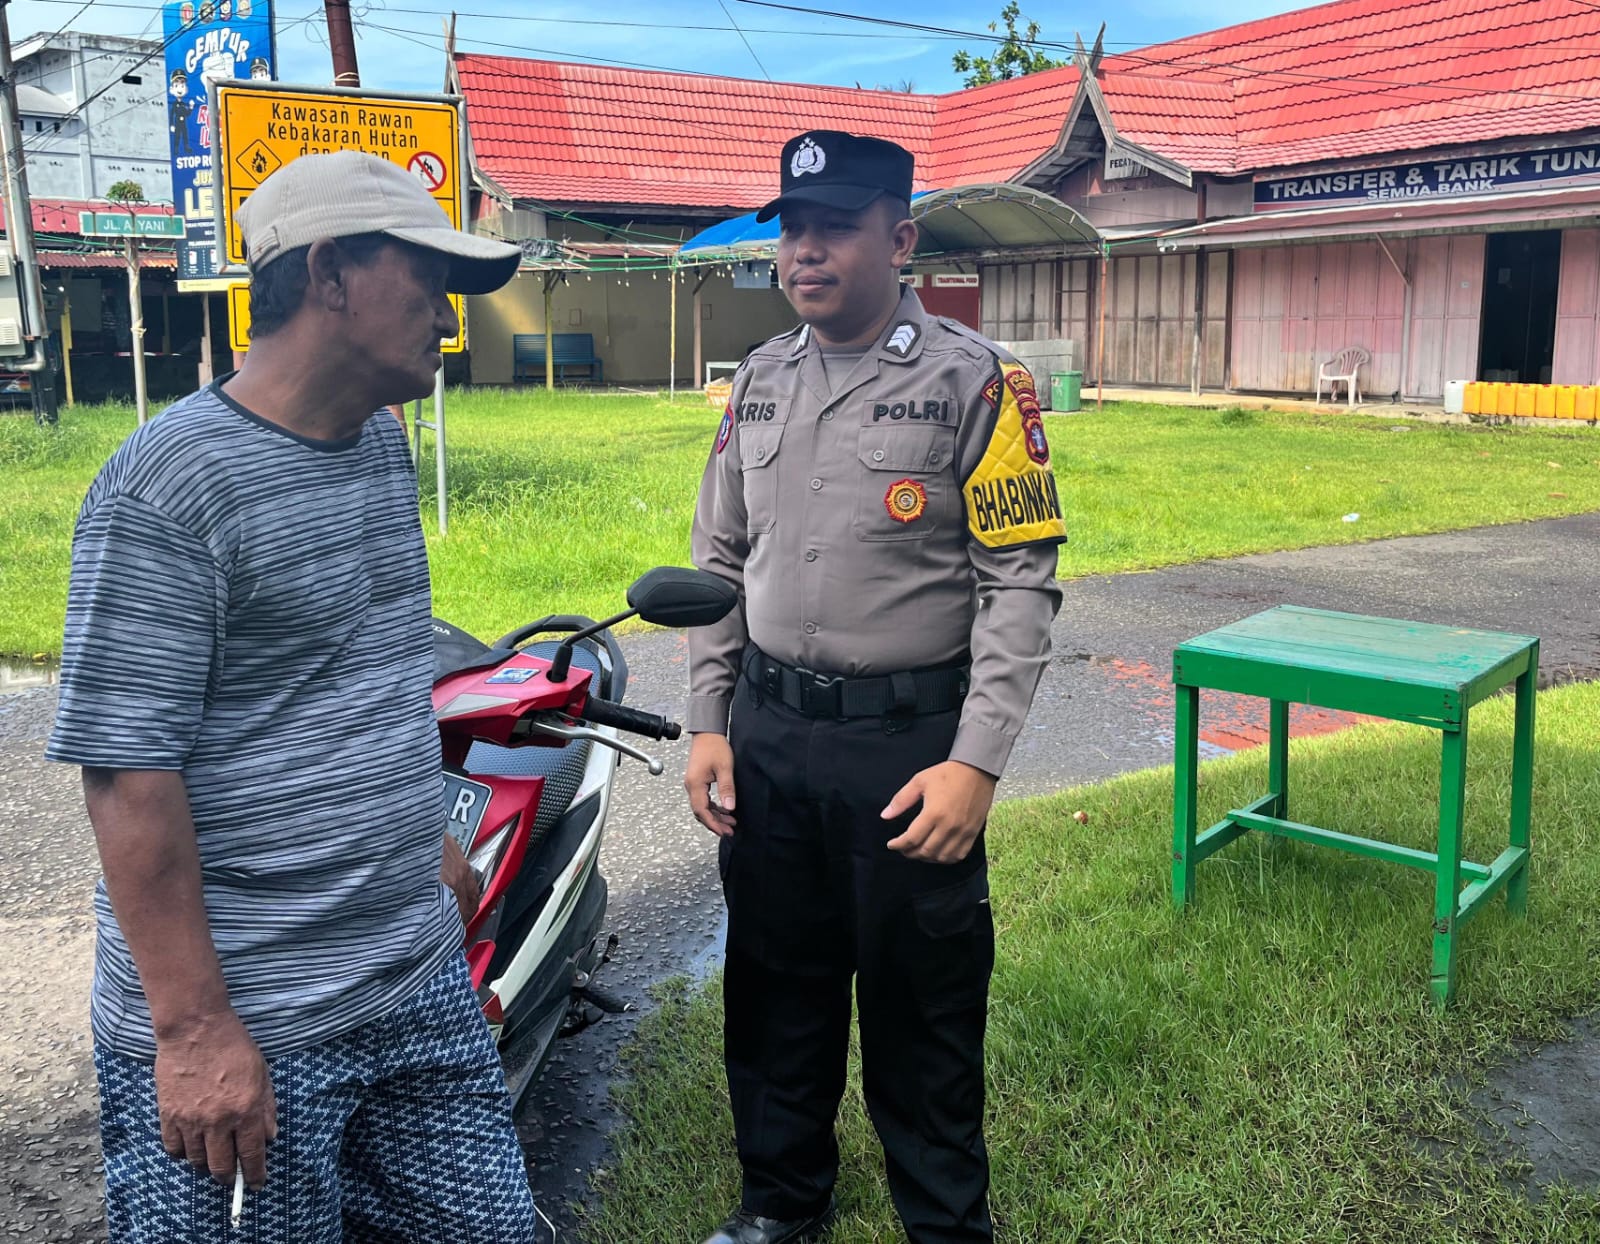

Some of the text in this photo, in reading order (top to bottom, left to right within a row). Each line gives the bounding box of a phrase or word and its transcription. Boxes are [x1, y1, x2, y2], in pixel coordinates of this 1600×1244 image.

[185, 27, 250, 73] GEMPUR
[271, 102, 413, 129] Kawasan Rawan
[267, 122, 418, 148] Kebakaran Hutan
[176, 155, 201, 169] STOP
[1269, 149, 1600, 200] TRANSFER & TARIK TUN
[1367, 179, 1494, 200] SEMUA BANK
[184, 187, 215, 219] LE
[103, 219, 121, 231] JL.
[137, 220, 165, 231] YANI
[872, 400, 948, 422] POLRI
[444, 782, 476, 824] R
